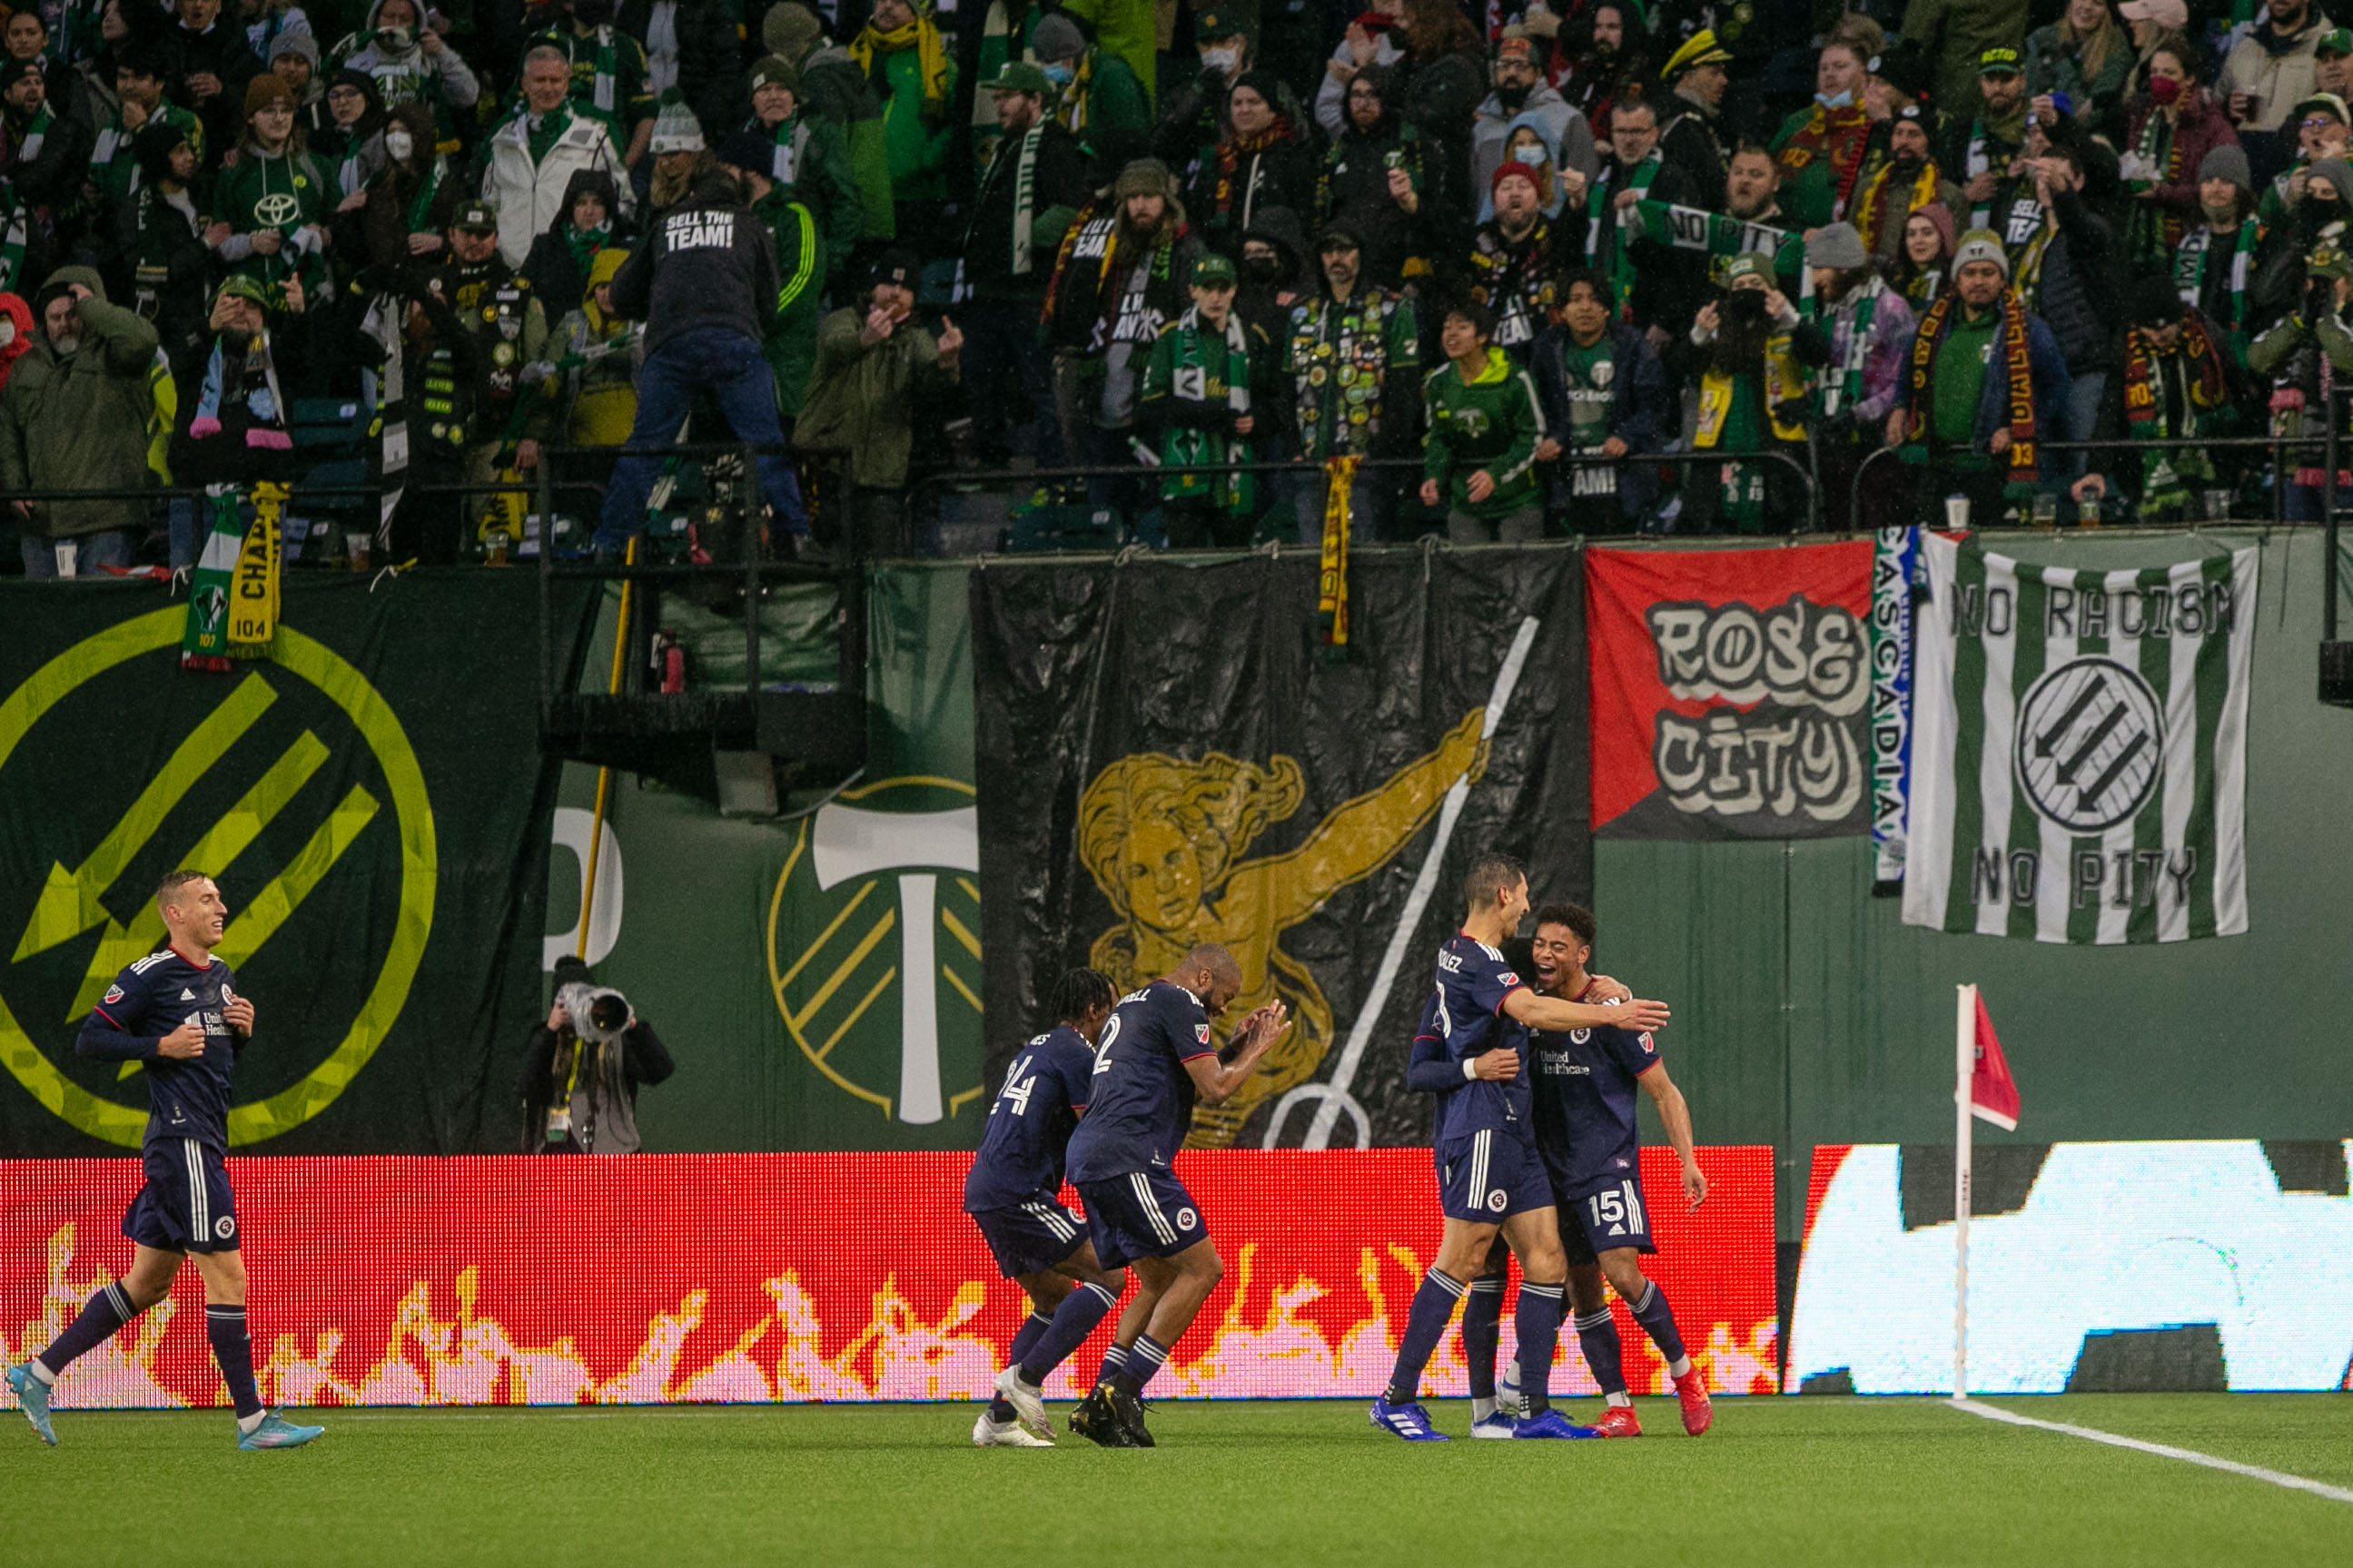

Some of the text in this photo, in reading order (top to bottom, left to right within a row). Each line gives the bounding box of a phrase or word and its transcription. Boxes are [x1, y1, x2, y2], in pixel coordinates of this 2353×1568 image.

[666, 225, 734, 251] TEAM!
[667, 210, 734, 230] SELL THE
[1664, 209, 1705, 243] NO
[236, 619, 265, 637] 104
[1952, 581, 2236, 640] NO RACISM
[1652, 599, 1854, 699] ROSE
[1875, 526, 1904, 827] CASCADIA
[1658, 715, 1849, 808] CITY
[1972, 846, 2197, 909] NO PITY
[1092, 1013, 1121, 1076] 2
[1540, 1051, 1568, 1063] United
[1542, 1063, 1590, 1075] Healthcare
[1588, 1190, 1625, 1227] 15
